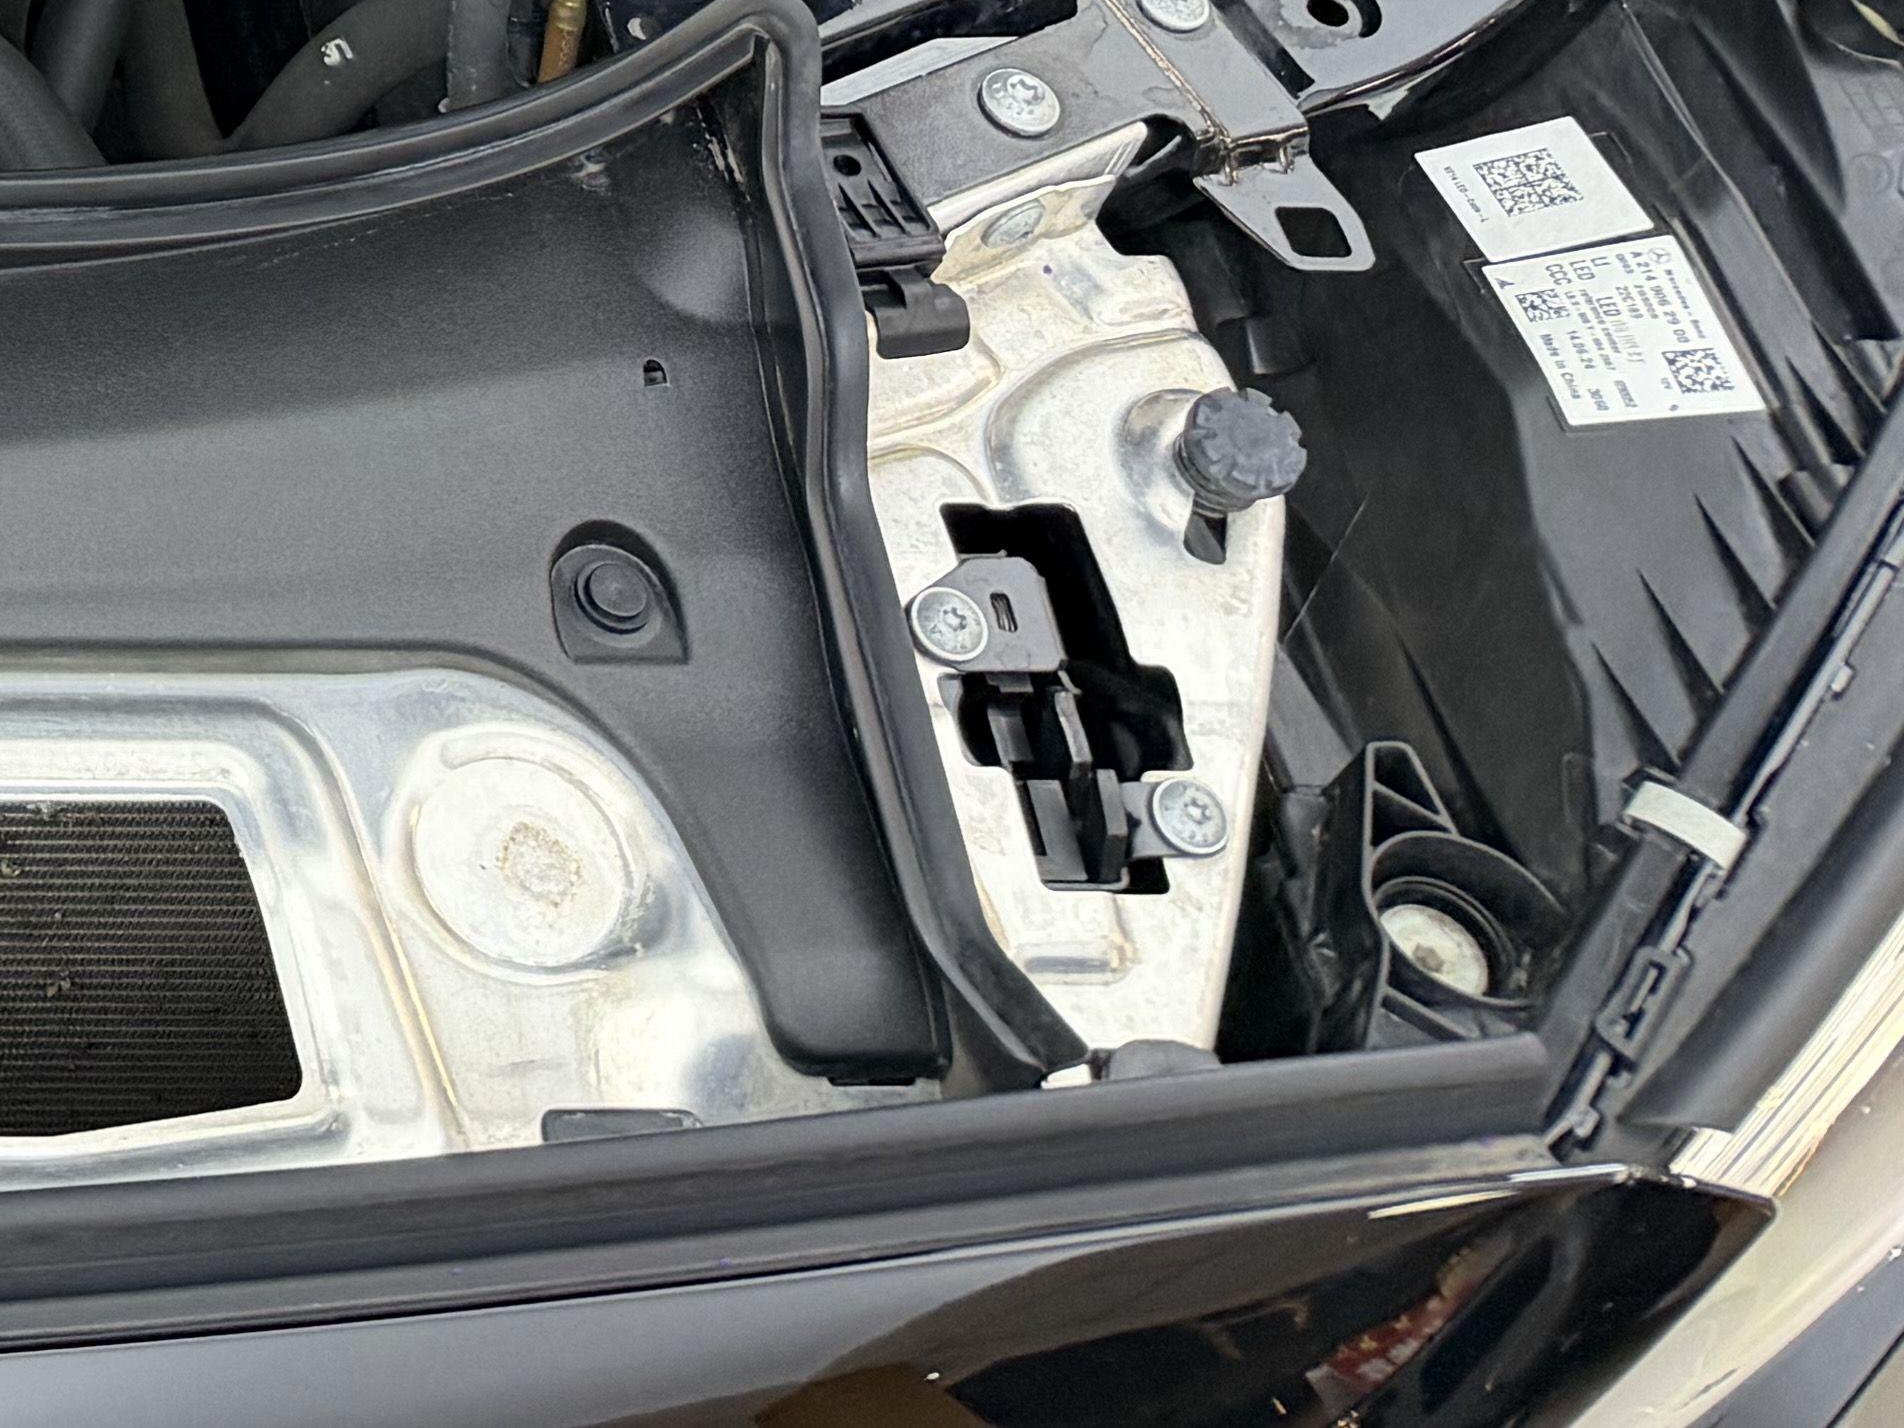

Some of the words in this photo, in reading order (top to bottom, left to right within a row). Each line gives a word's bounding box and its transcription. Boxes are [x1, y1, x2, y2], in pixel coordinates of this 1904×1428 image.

[1628, 249, 1643, 259] A
[1543, 262, 1572, 286] CCC
[1634, 260, 1656, 282] 214
[1567, 259, 1595, 281] LED
[1594, 295, 1622, 318] LED
[1661, 310, 1681, 325] 29
[1538, 332, 1562, 357] Made
[1558, 371, 1585, 399] China
